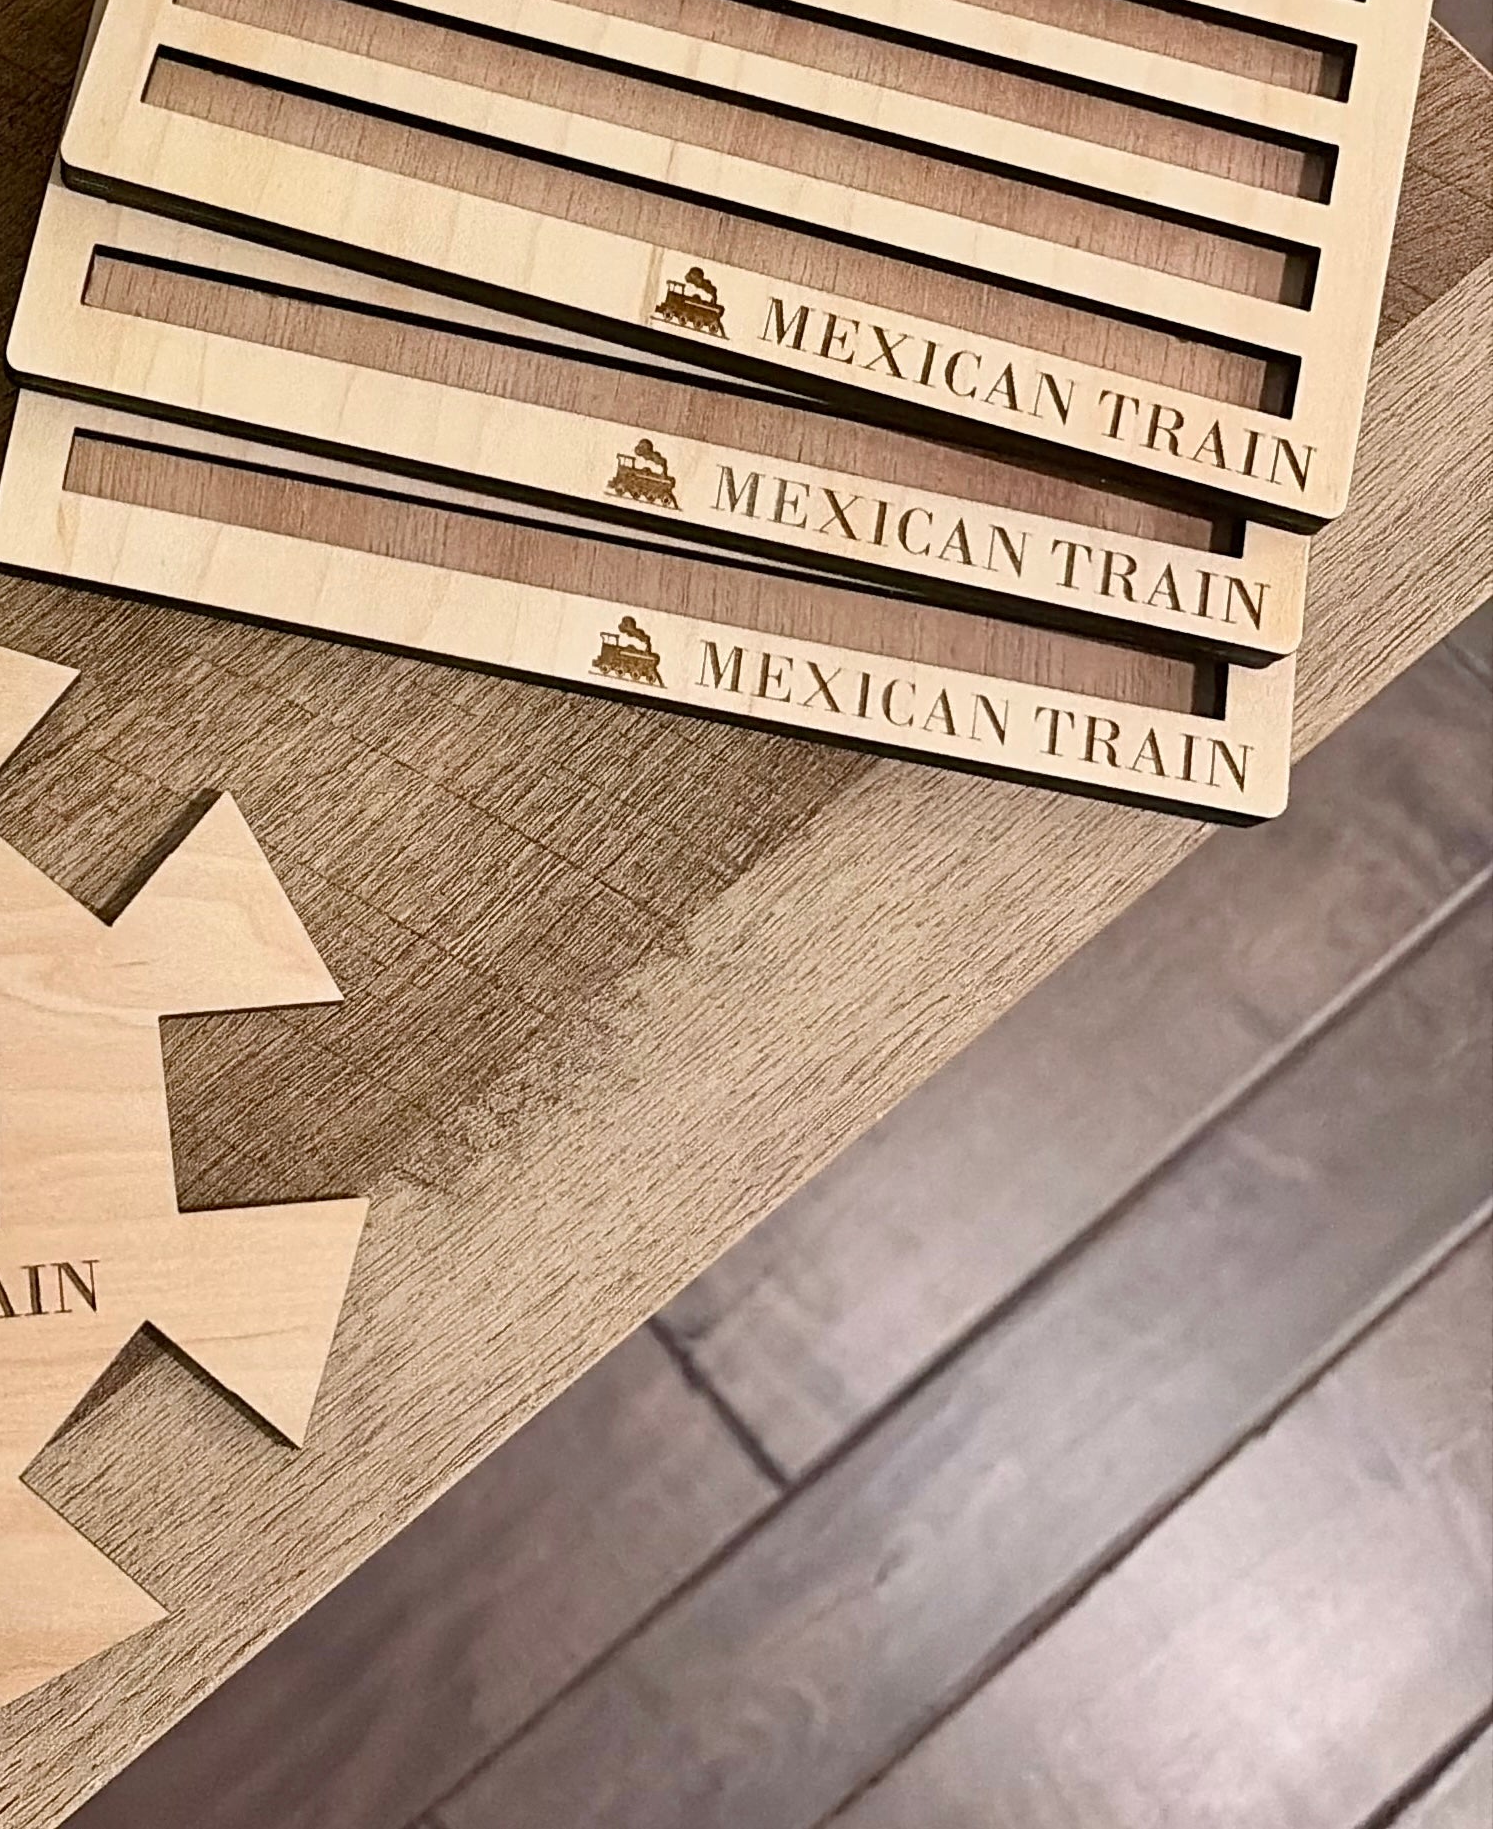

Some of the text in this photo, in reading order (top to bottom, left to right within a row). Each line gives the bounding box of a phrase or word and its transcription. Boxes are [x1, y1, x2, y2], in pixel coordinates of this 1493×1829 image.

[757, 296, 1318, 493] MEXICAN TRAIN
[710, 465, 1271, 630] MEXICAN TRAIN
[694, 639, 1255, 794] MEXICAN TRAIN
